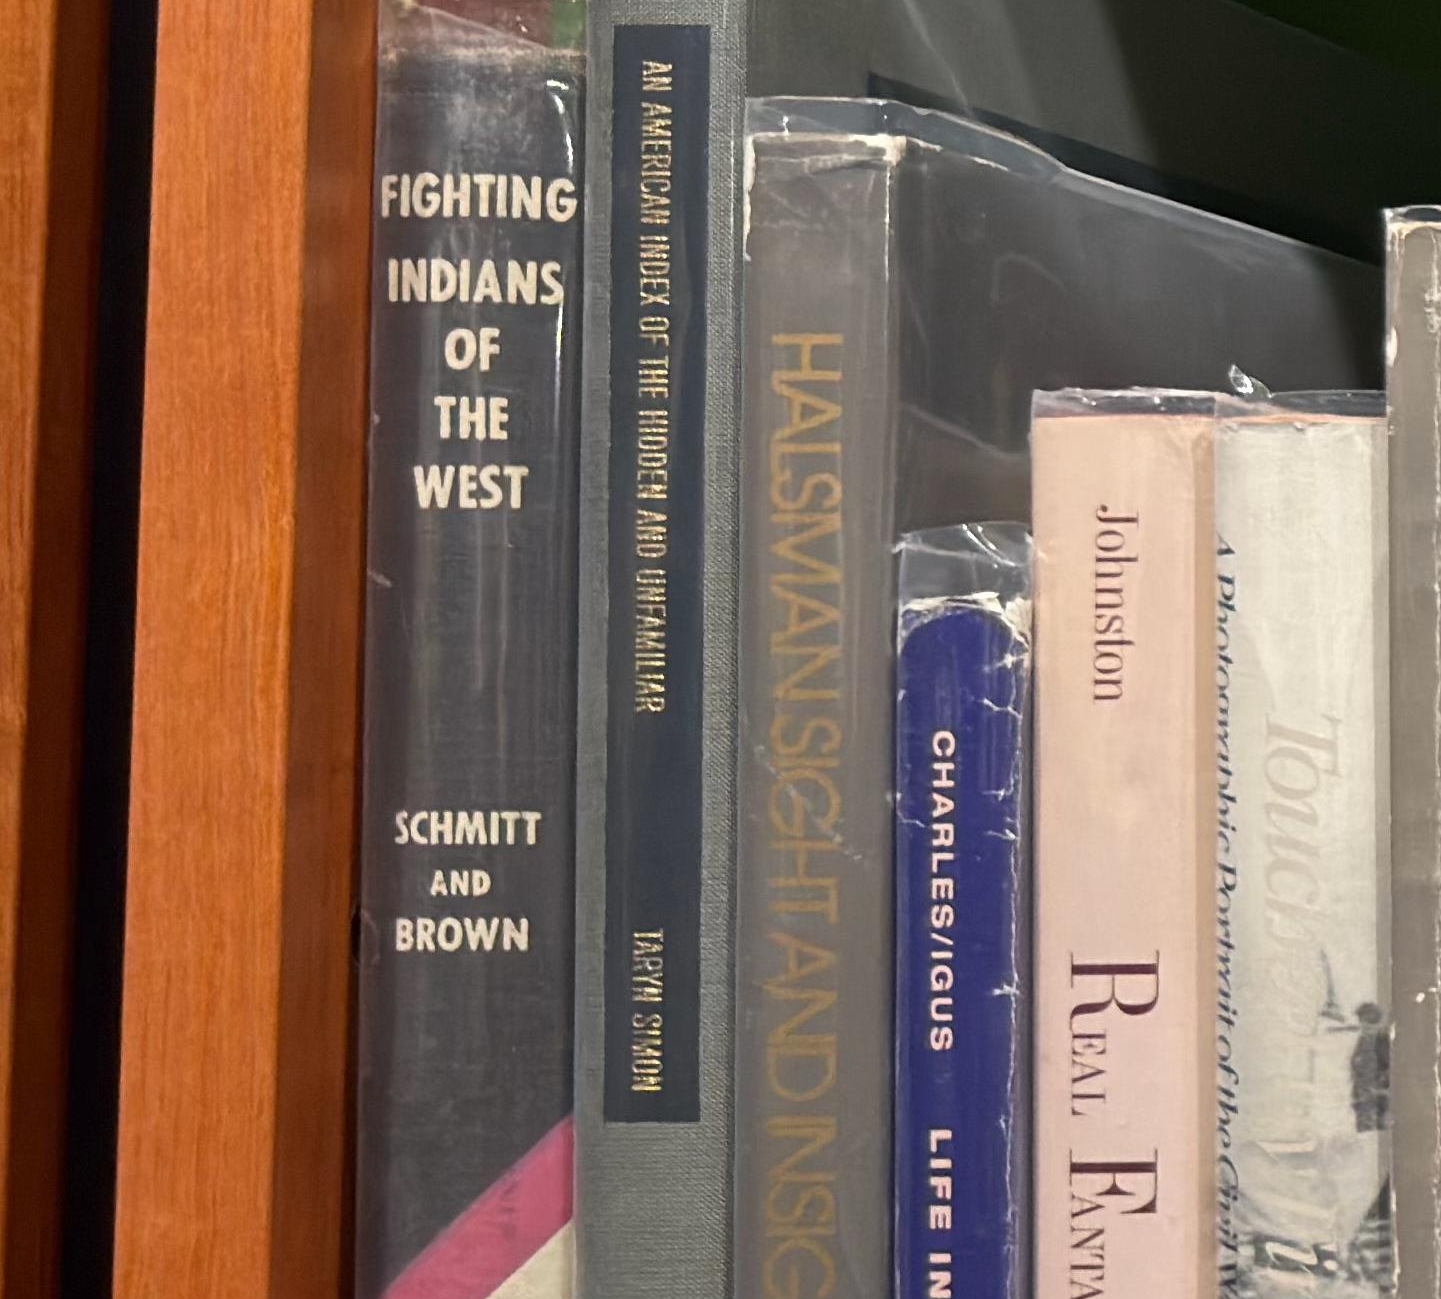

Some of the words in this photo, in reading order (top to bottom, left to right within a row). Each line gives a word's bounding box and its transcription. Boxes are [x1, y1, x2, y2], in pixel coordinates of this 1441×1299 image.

[641, 60, 671, 92] AN
[639, 102, 671, 225] AMERICAN
[381, 172, 577, 222] FIGHTING
[388, 258, 564, 305] INDIANS
[638, 235, 670, 306] INDEX
[444, 327, 501, 372] OF
[638, 316, 669, 349] OF
[637, 355, 668, 399] THE
[434, 395, 509, 441] THE
[636, 409, 668, 499] HIDDEN
[414, 466, 529, 509] WEST
[635, 509, 667, 559] AND
[770, 333, 843, 700] HALSMAN
[1092, 504, 1139, 703] Johnston
[634, 568, 667, 712] UNFAMILIAR
[395, 810, 542, 846] SCHMITT
[769, 716, 841, 923] SIGHT
[430, 869, 492, 896] AND
[929, 730, 956, 1051] CHARLES/IGUS
[395, 916, 530, 952] BROWN
[632, 928, 665, 1002] TARYN
[768, 934, 840, 1101] AND
[631, 1013, 664, 1092] SIMON
